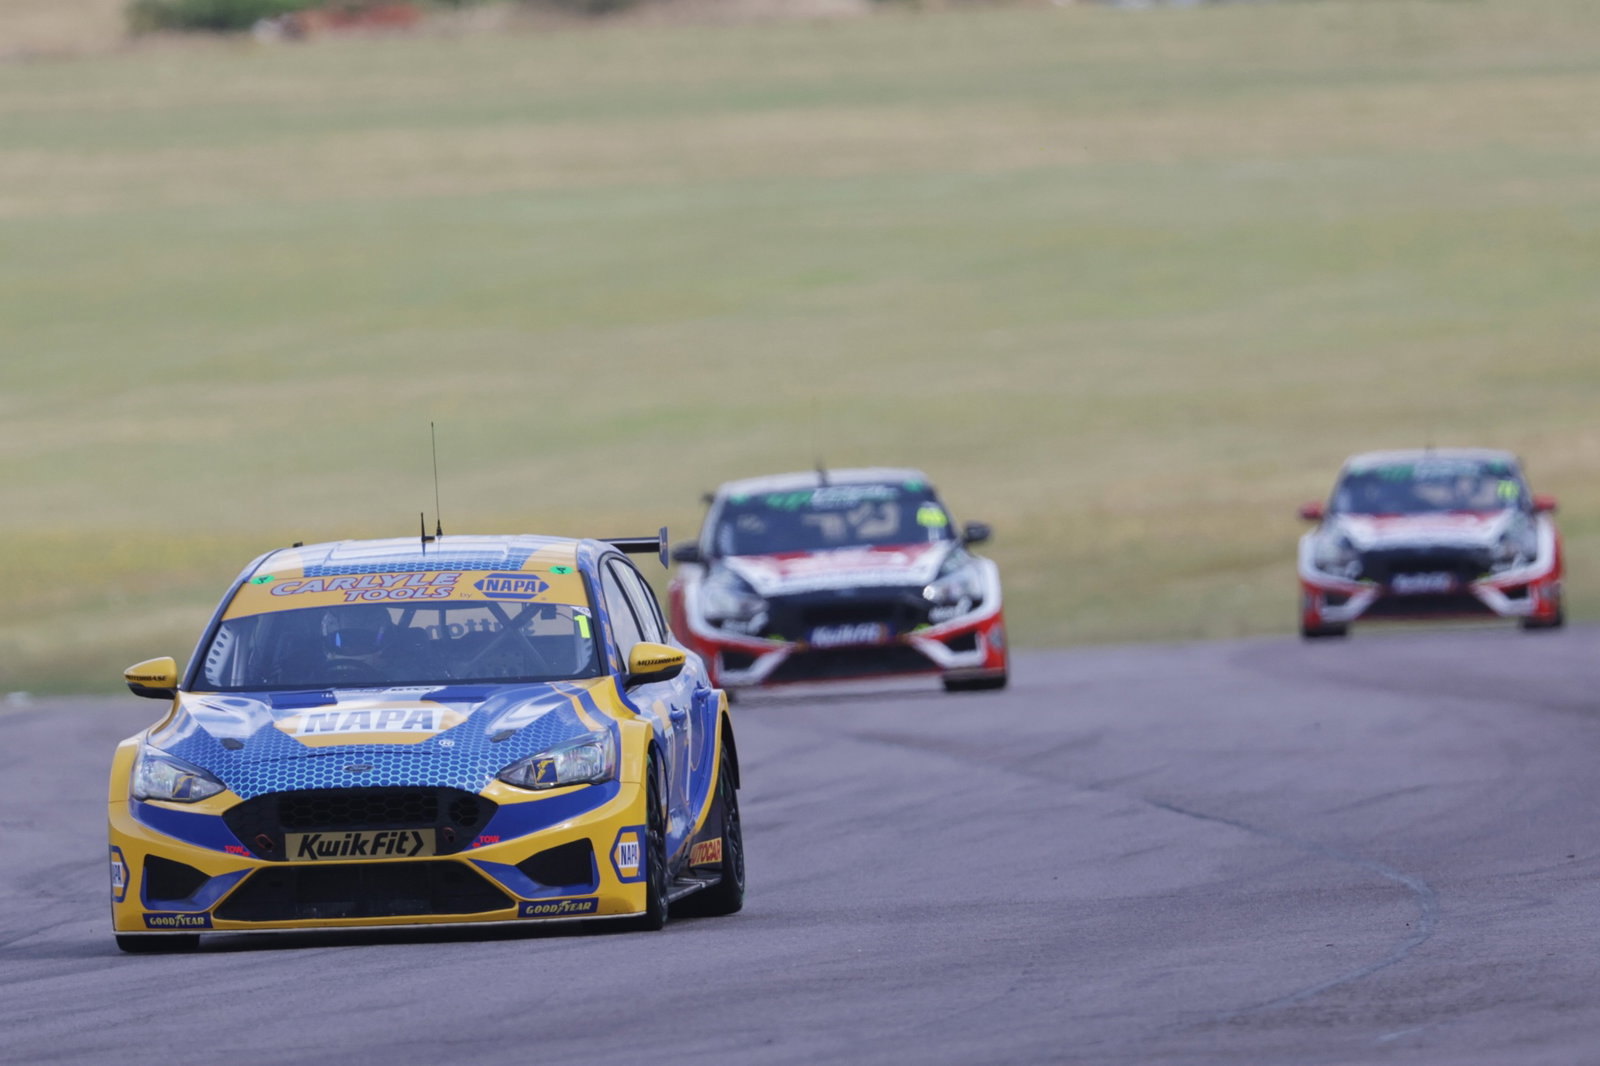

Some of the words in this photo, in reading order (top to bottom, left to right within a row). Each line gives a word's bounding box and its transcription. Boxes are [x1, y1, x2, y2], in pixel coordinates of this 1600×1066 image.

[271, 573, 462, 596] CARLYLE
[486, 580, 536, 593] NAPA
[344, 587, 453, 602] TOOLS
[574, 615, 591, 639] 1
[304, 710, 433, 733] NAPA
[480, 835, 499, 844] TOW
[224, 845, 244, 854] TOW
[620, 844, 638, 866] NAPA
[526, 900, 592, 915] GOODYEAR
[149, 915, 205, 927] GOODYEAR
